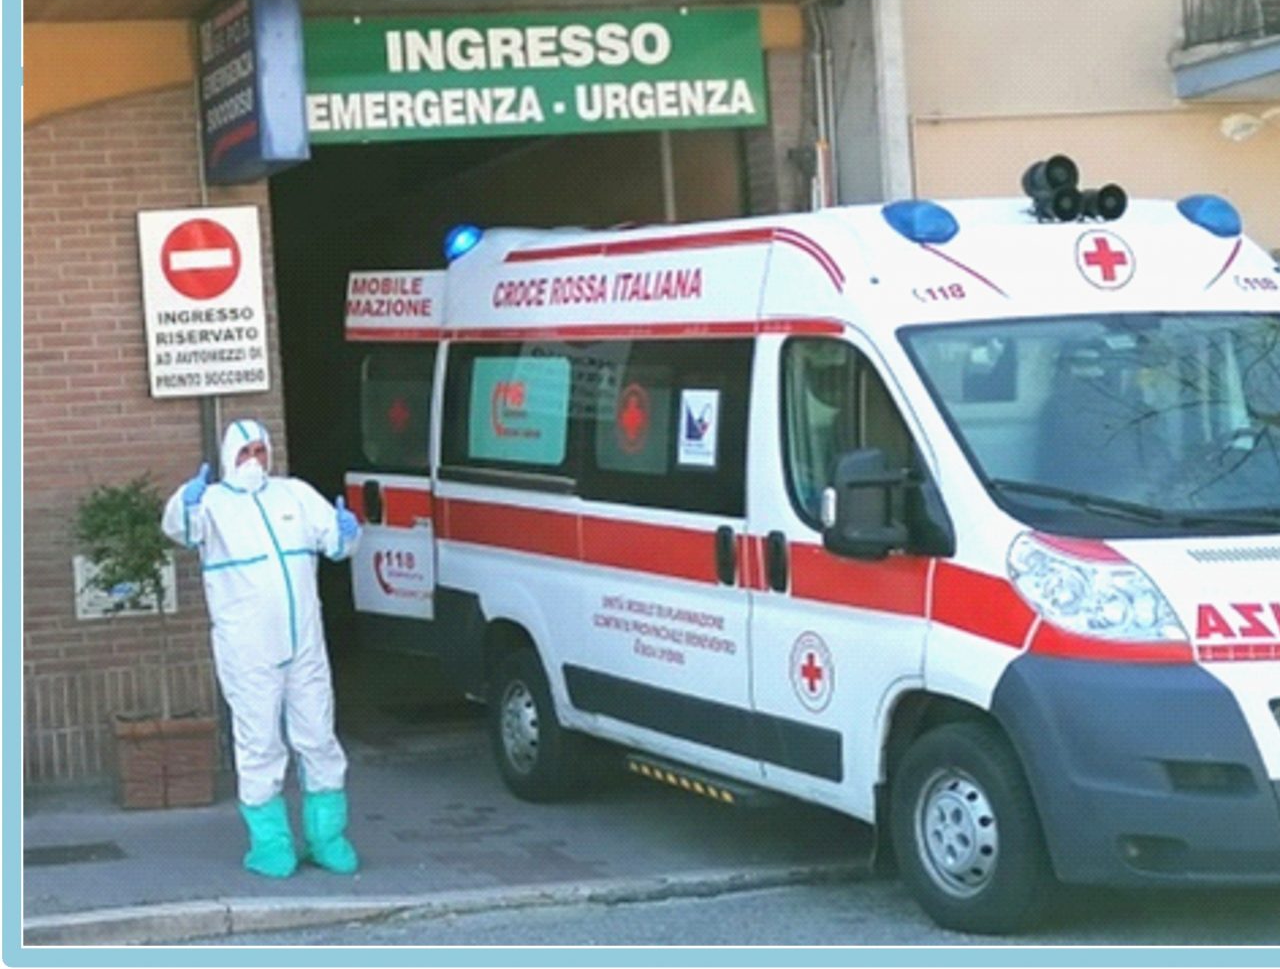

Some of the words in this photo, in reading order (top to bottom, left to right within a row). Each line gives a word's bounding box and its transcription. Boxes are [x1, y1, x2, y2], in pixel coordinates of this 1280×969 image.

[386, 21, 672, 73] INGRESSO
[306, 86, 544, 132] EMERGENZA
[576, 79, 755, 122] URGENZA
[351, 277, 423, 296] MOBILE
[492, 277, 547, 309] CROCE
[551, 273, 606, 304] ROSSA
[611, 268, 702, 301] ITALIANA
[925, 283, 966, 301] 118
[157, 307, 254, 325] INGRESSO
[345, 299, 432, 317] MAZIONE
[155, 327, 258, 346] RISERVATO
[385, 550, 416, 570] 118
